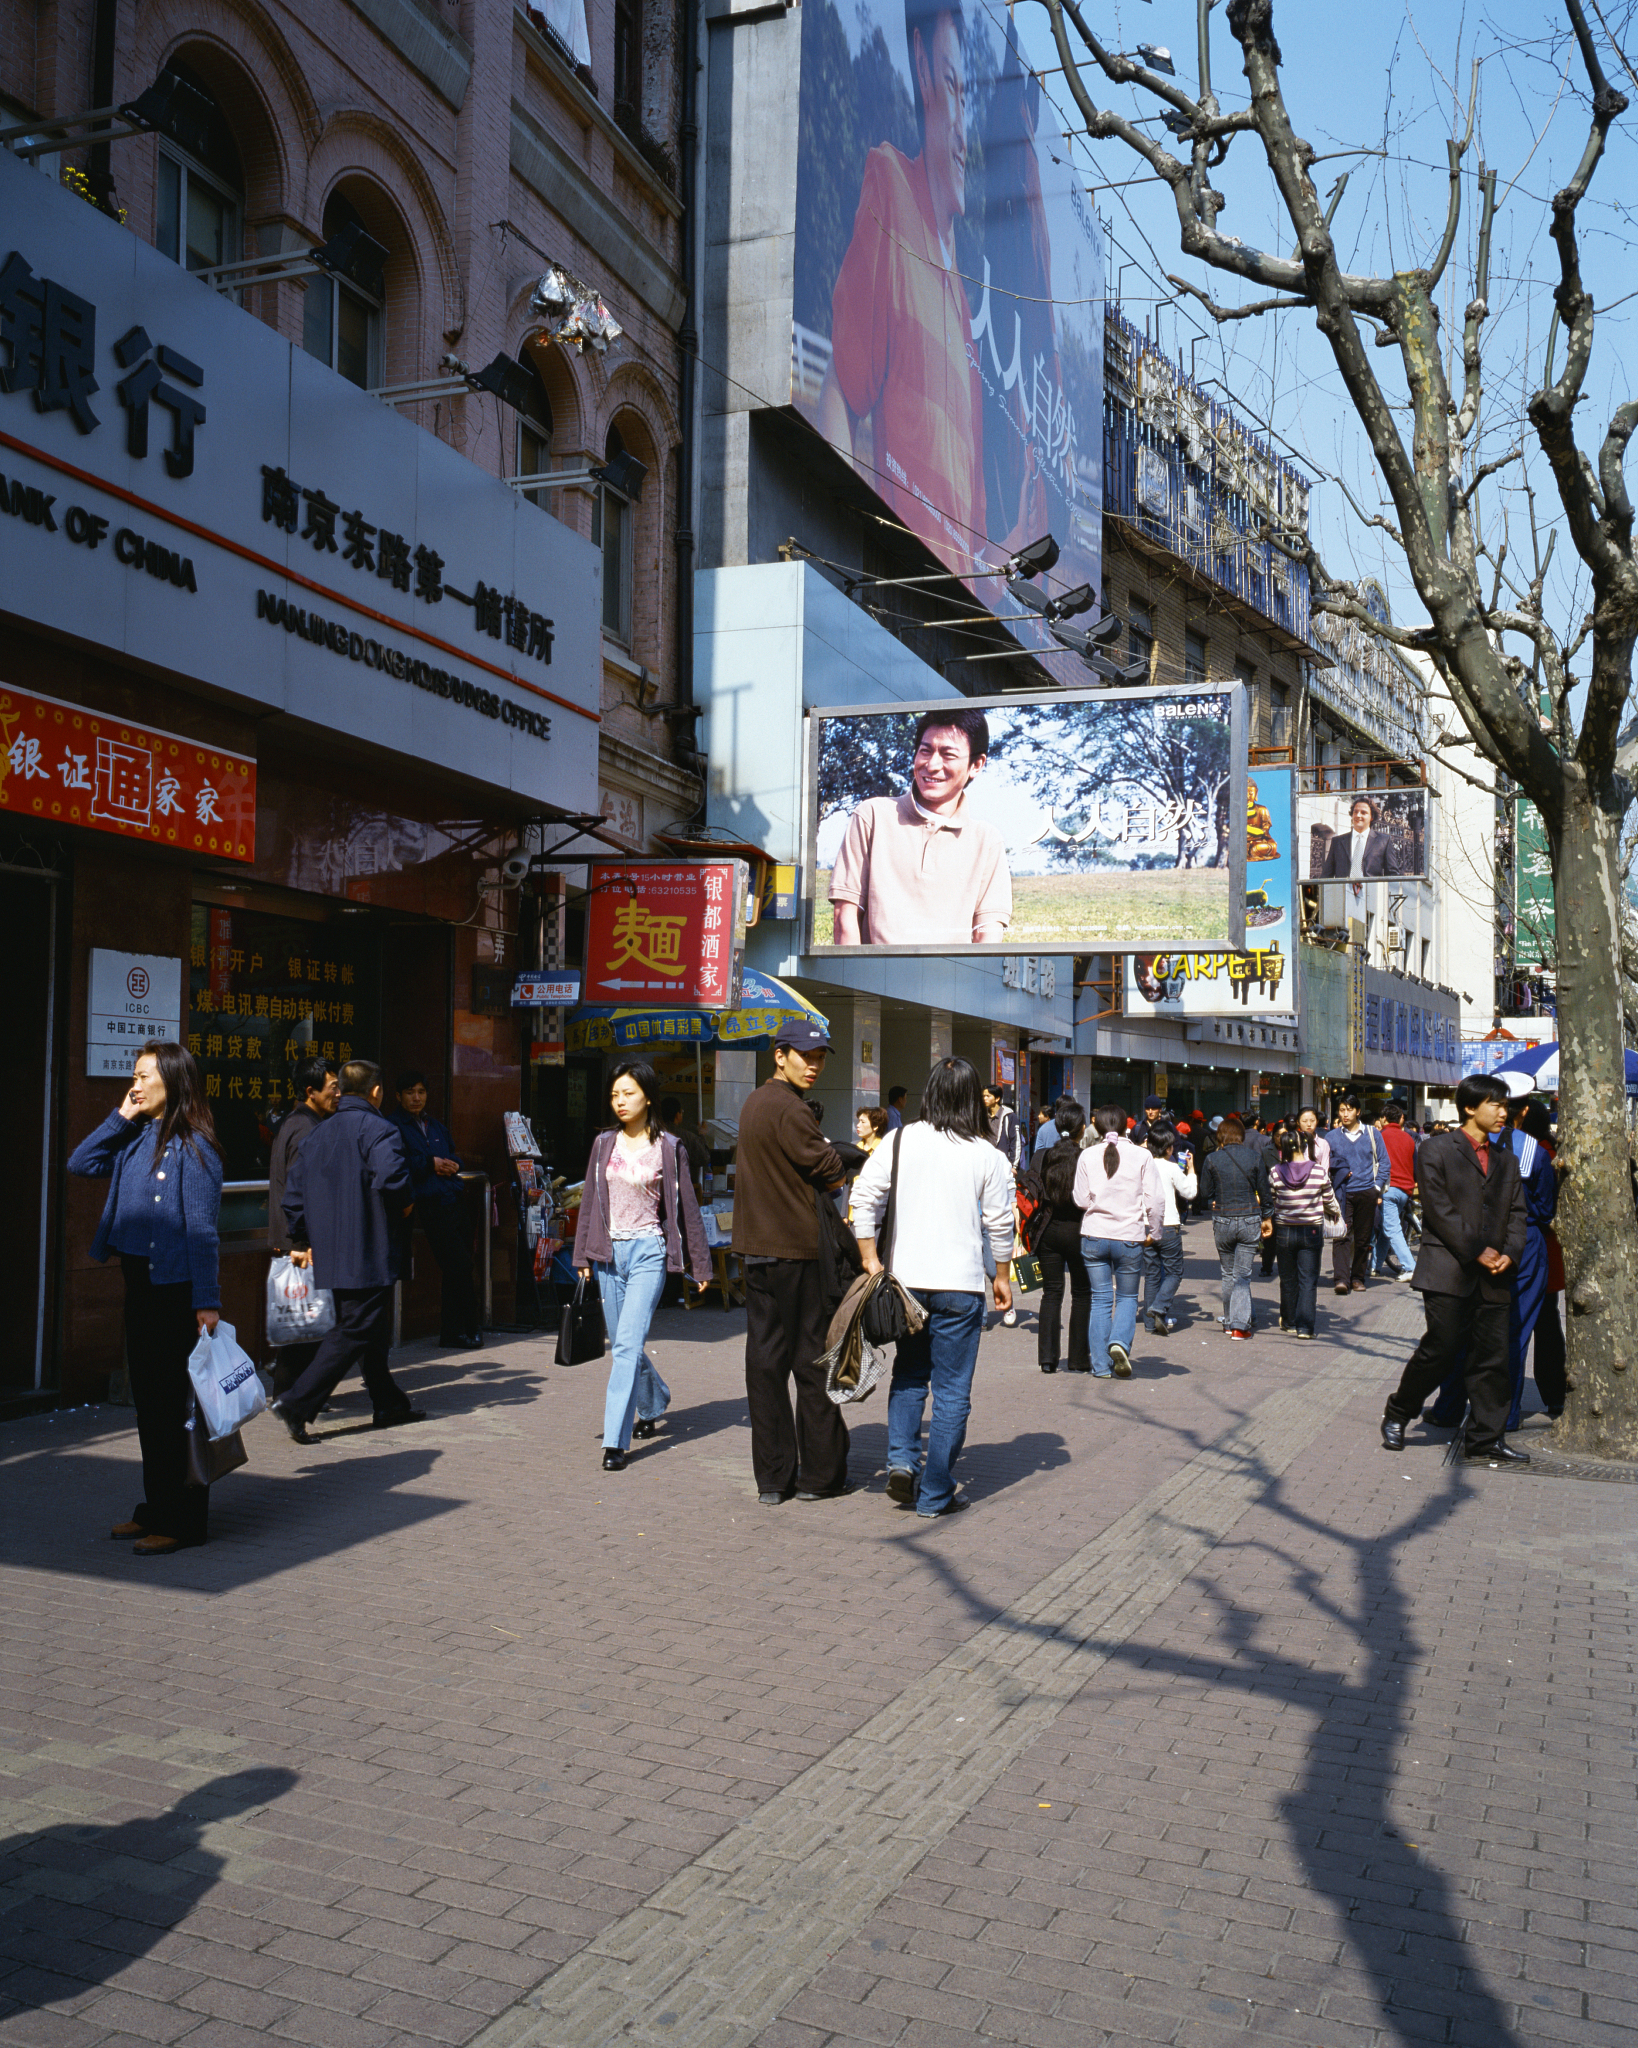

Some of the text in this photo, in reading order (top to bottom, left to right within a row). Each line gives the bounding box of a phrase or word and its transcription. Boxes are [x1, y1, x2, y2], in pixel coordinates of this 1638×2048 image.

[969, 255, 1078, 498] 人人自然
[66, 506, 109, 549] OF
[115, 528, 198, 593] CHINA
[261, 464, 556, 666] 南京东路第一储蓄所
[257, 588, 349, 655] NANJING
[349, 631, 405, 679] DONG
[438, 670, 501, 719] SAVINGS
[501, 699, 552, 741] OFFICE
[1031, 798, 1209, 845] 人人自然
[700, 875, 723, 988] 银都酒家
[190, 944, 354, 985] 银行开户 银证转帐
[1153, 948, 1270, 980] CARPET
[125, 1002, 150, 1014] ICBC
[537, 984, 573, 994] 公用电话
[107, 1021, 166, 1036] 中国工商银行
[188, 1033, 262, 1060] 质押贷款
[625, 1018, 702, 1039] 中国体育彩票
